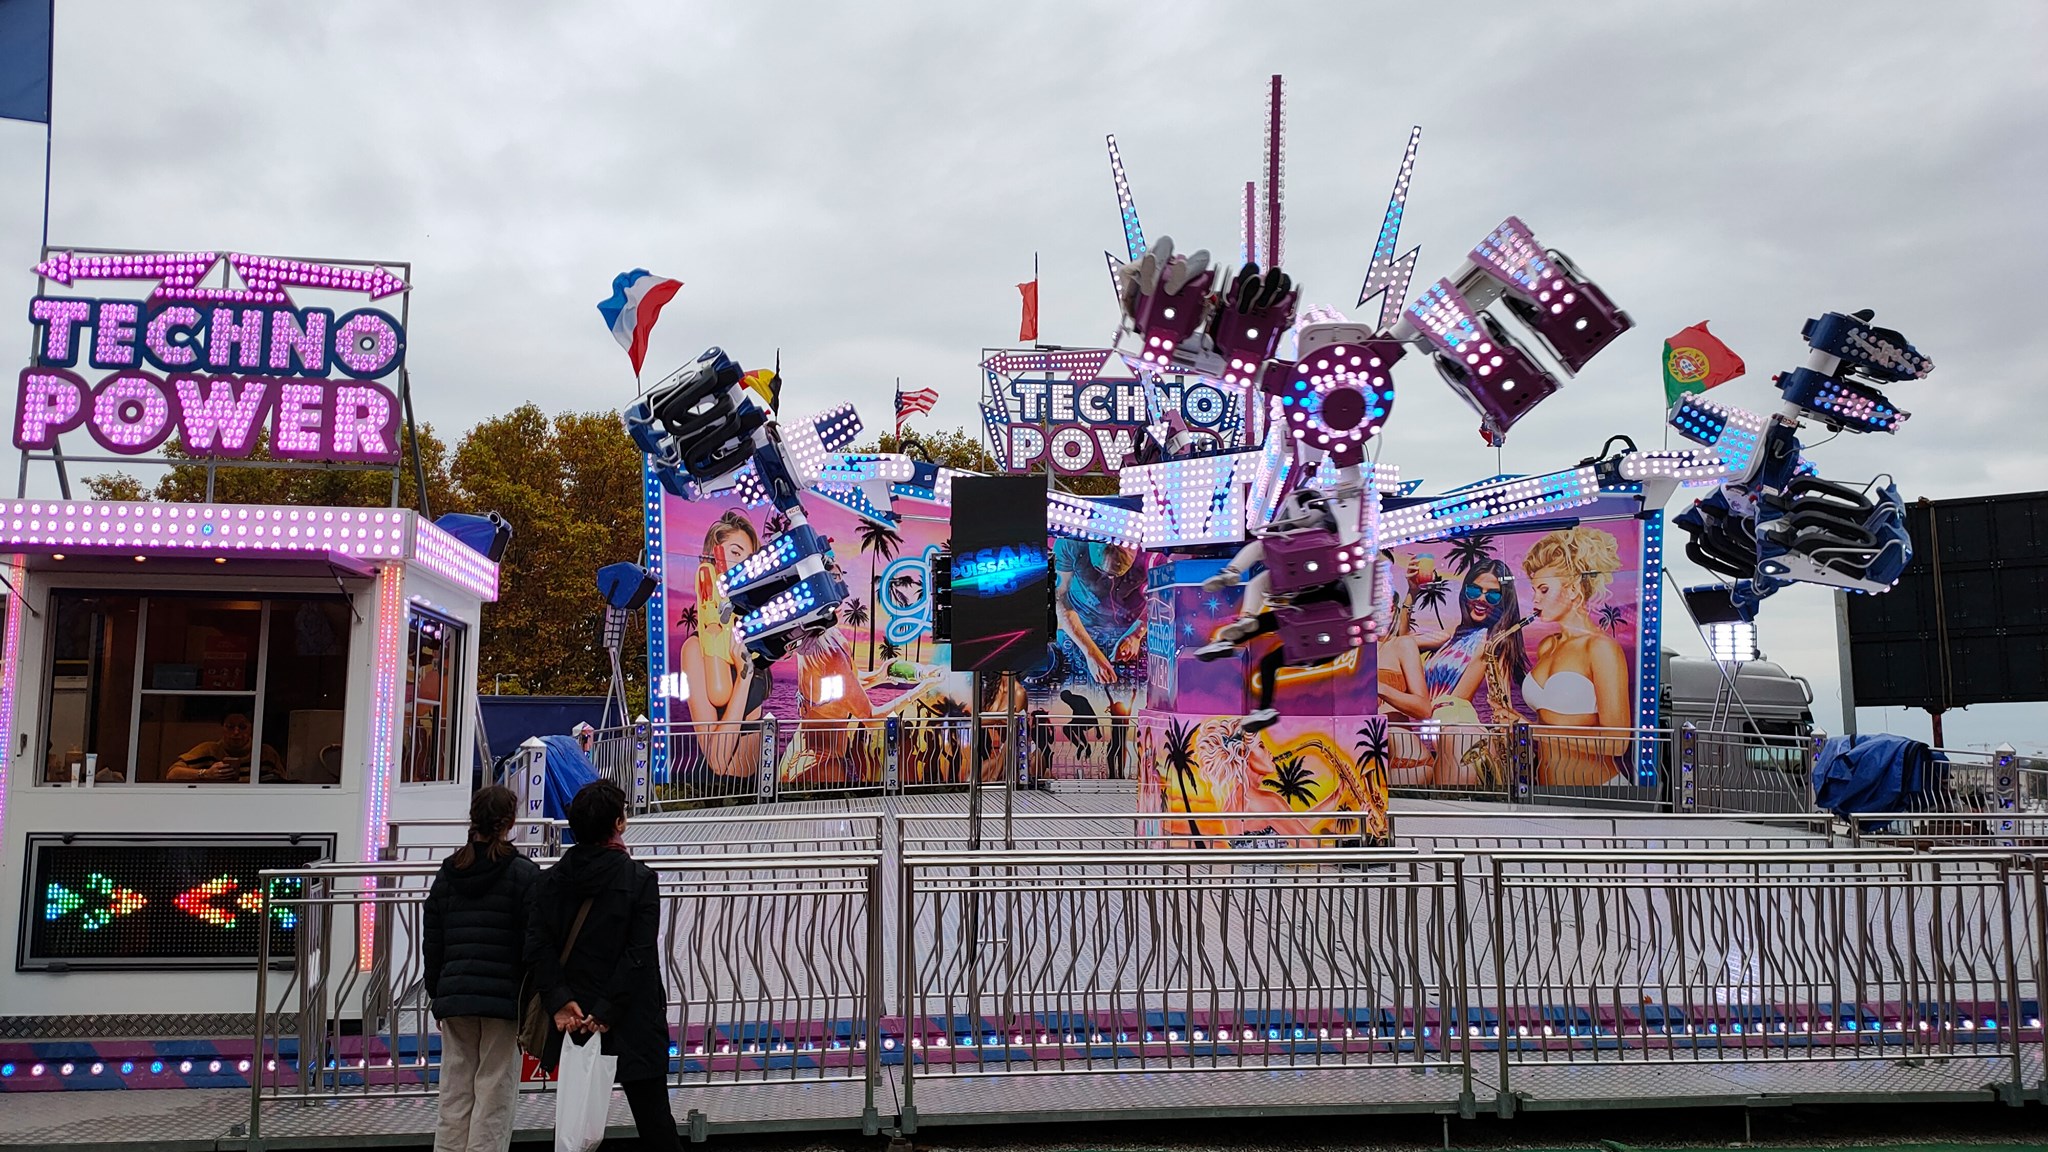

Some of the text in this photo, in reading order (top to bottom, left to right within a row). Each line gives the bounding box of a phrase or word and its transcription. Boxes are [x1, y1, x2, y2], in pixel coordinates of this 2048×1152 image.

[31, 299, 399, 373] TECHNO
[20, 373, 392, 455] POWER
[1015, 382, 1224, 424] TECHNO
[529, 751, 543, 858] POWER
